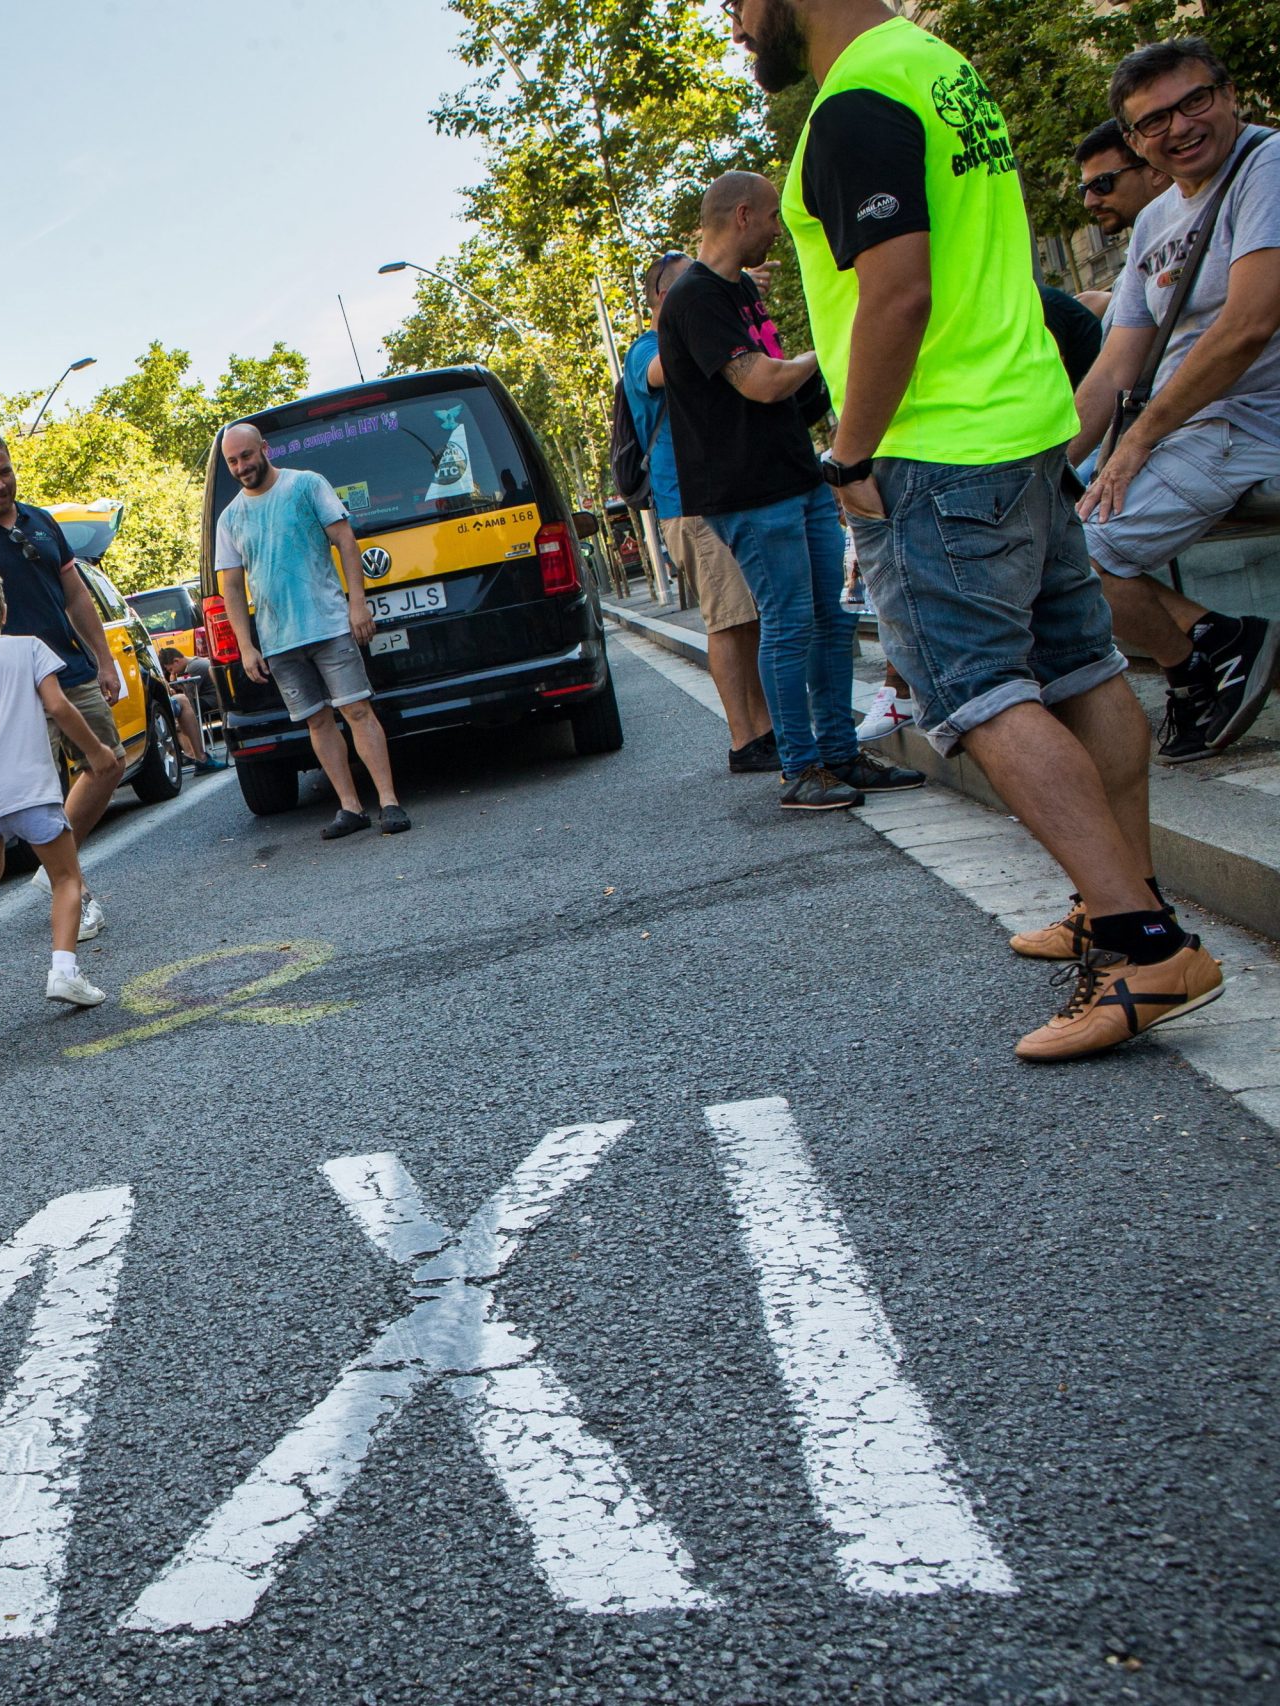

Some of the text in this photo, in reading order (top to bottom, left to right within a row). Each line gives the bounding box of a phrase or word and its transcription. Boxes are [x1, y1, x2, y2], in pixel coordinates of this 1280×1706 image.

[288, 440, 301, 453] se
[303, 425, 344, 447] cumpla
[345, 422, 357, 437] la
[358, 416, 379, 435] LEY
[485, 517, 506, 528] AMB
[512, 511, 534, 523] 168
[512, 542, 531, 552] TDI
[400, 588, 439, 612] JLS
